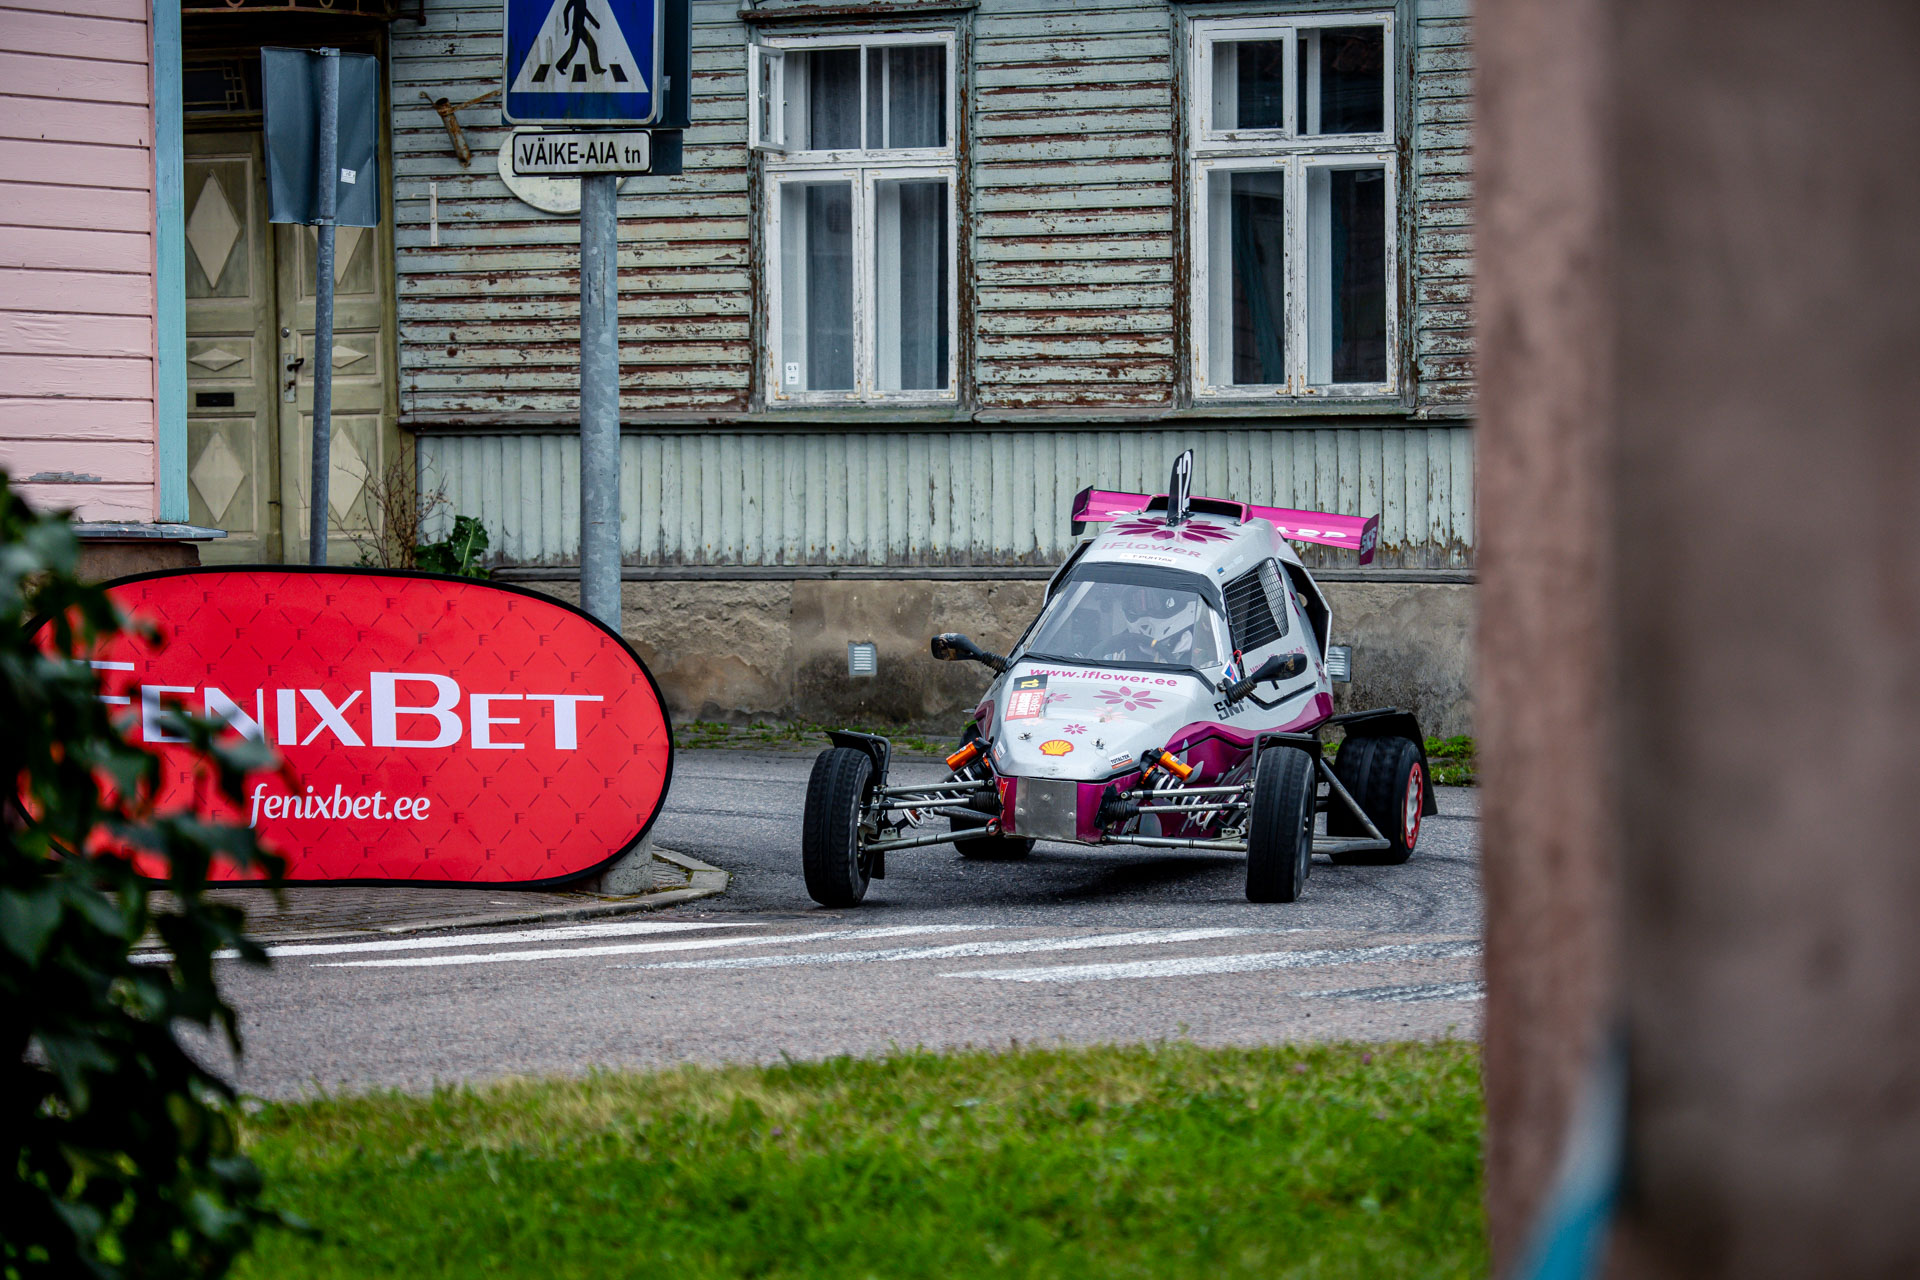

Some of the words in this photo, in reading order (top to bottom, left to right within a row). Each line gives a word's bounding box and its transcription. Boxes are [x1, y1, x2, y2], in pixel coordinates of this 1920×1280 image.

[522, 137, 618, 166] VÄIKE-AIA
[624, 145, 641, 164] tn
[1176, 450, 1192, 519] 12
[1029, 668, 1178, 687] www.iflower.ee
[248, 782, 431, 829] fenixbet.ee
